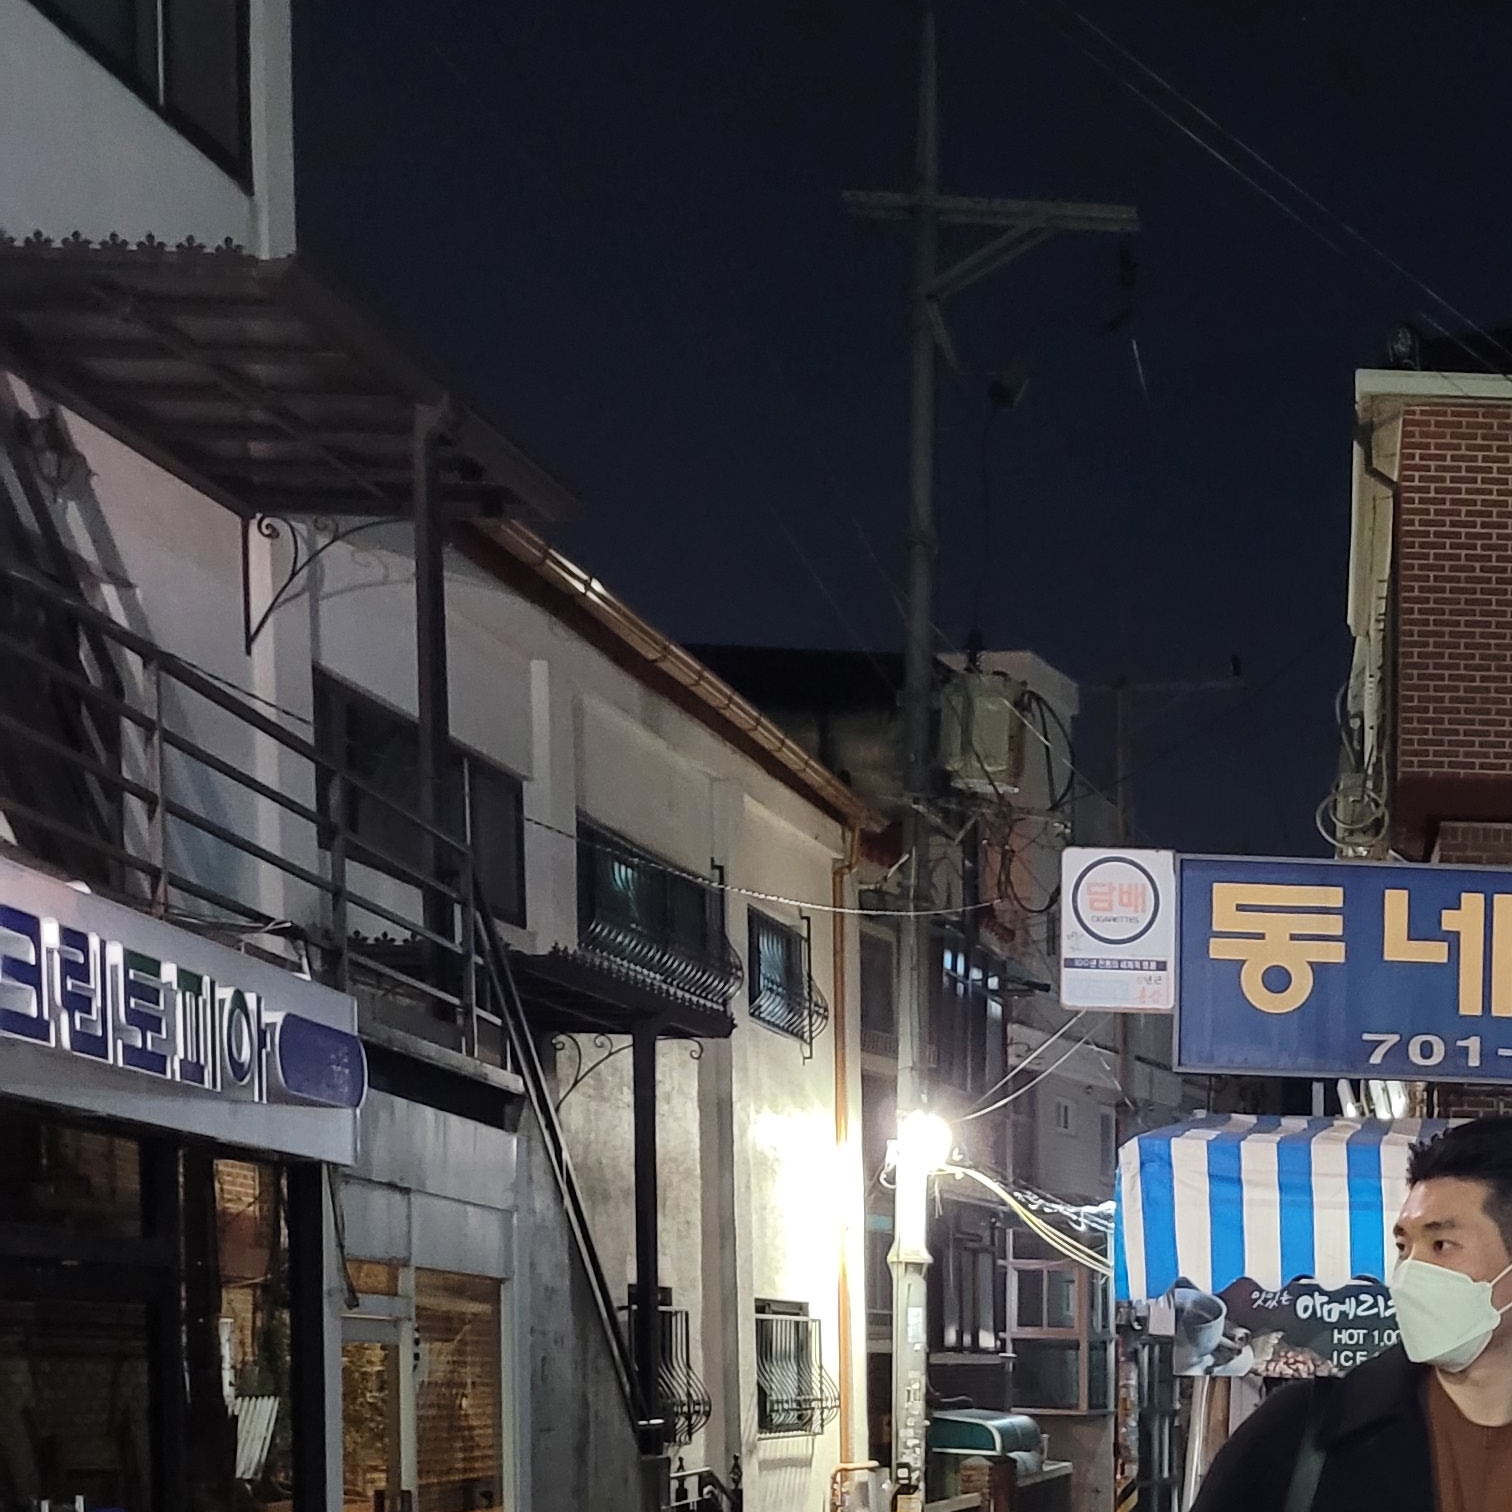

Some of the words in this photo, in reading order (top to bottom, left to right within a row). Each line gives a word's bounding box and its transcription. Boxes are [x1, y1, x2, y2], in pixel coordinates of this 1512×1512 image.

[1086, 881, 1147, 913] 담배
[1091, 915, 1140, 924] CIGARETTES
[1333, 1328, 1368, 1344] HOT
